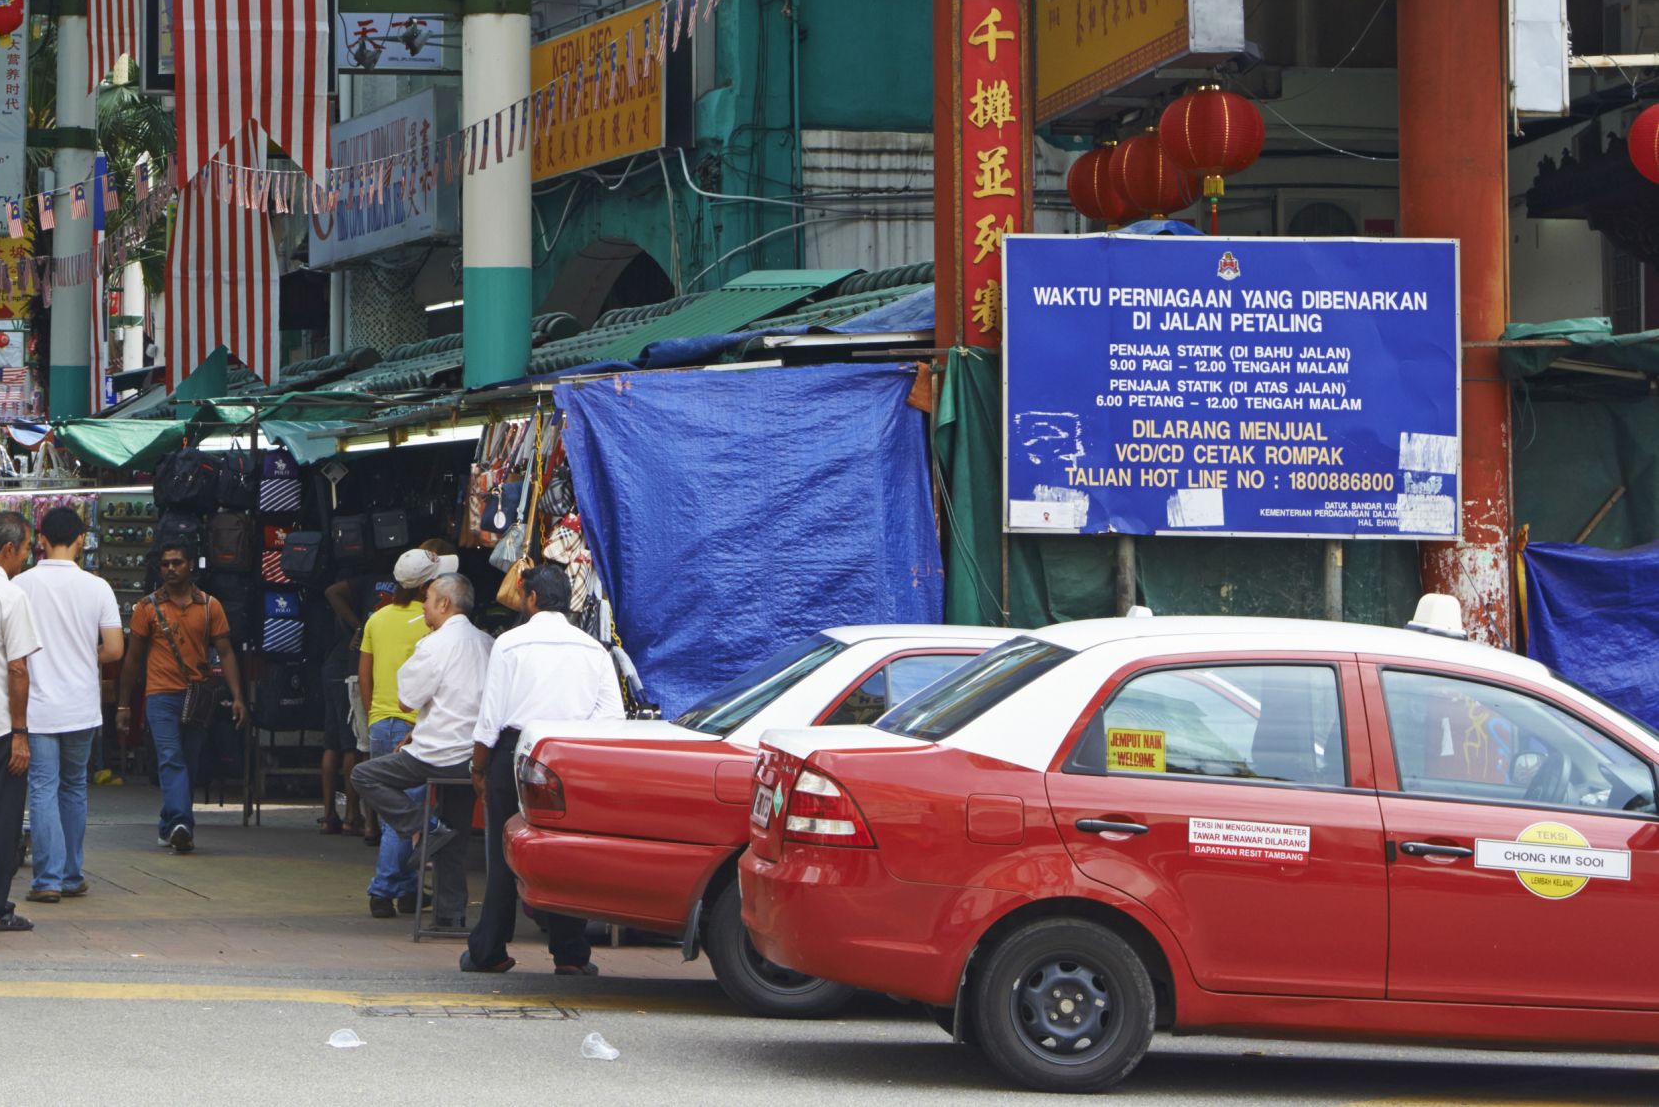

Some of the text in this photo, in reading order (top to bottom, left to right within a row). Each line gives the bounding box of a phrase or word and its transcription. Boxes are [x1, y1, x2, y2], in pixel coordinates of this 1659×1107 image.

[1033, 287, 1428, 310] WAKTU PERNIAGAAN YANG DIBENARKAN
[1133, 312, 1323, 333] DI JALAN PETALING
[1110, 344, 1351, 361] PENJAJA STATIK (DI BAHU JALAN)
[1110, 359, 1349, 374] 9.00 PAGI 12.00 TENGAH MALAM
[1110, 380, 1346, 397] PENJAJA STATIK (DI ATAS JALAN)
[1096, 395, 1362, 410] 6.00 PETANG 12.00 TENGAH MALAM
[1132, 420, 1328, 441] DILARANG MENJUAL
[1115, 444, 1344, 466] VCD/CD CETAK ROMPAK
[1065, 467, 1394, 492] TALIAN HOT LINE NO 1800886800
[1260, 509, 1312, 517] KEMENTERIAN
[1314, 509, 1370, 518] PERDAGANGAN
[1325, 502, 1381, 510] DATUK BANDAR
[1358, 519, 1373, 527] HAL
[1110, 732, 1163, 750] JEMPUT NAIK
[1117, 753, 1156, 768] WELCOME
[1193, 820, 1307, 836] TEKSI INI MENGGUNAKAN METER
[1536, 830, 1568, 841] TEKSI
[1193, 831, 1306, 848] TAWAR MENAWAR DILARANG
[1195, 845, 1303, 861] DAPATKAN RESIT TAMBANG
[1504, 851, 1604, 868] CHONG KIM SOOI
[1531, 877, 1574, 888] LEMBAH KELANG
